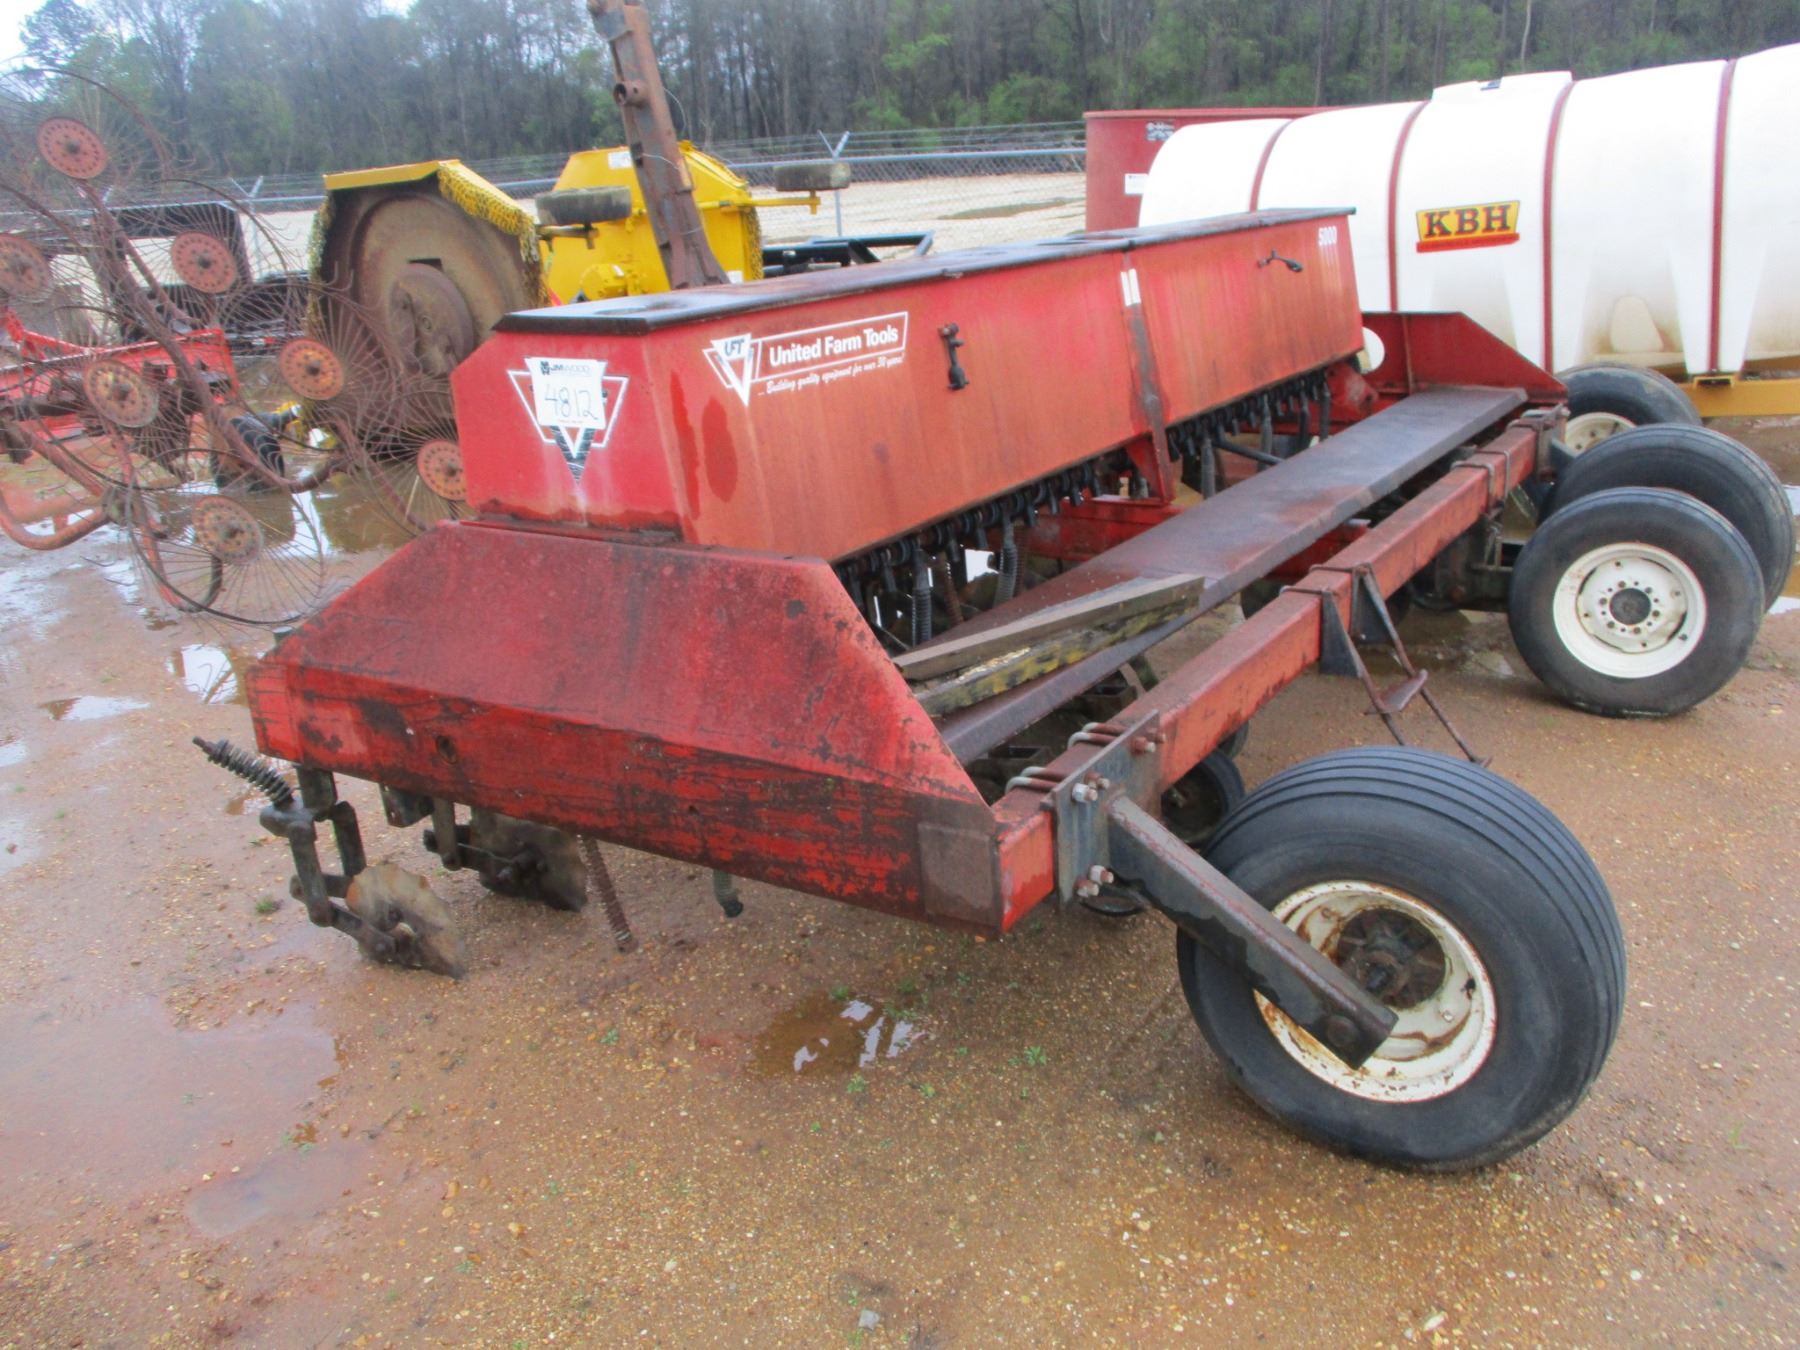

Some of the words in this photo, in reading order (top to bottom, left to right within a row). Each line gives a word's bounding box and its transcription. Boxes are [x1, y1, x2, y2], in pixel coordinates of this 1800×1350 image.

[1423, 204, 1512, 238] KBH
[724, 338, 745, 357] UFT
[769, 338, 821, 367] United
[824, 334, 861, 355] Farm
[863, 324, 899, 347] Tools
[544, 383, 598, 421] 4812
